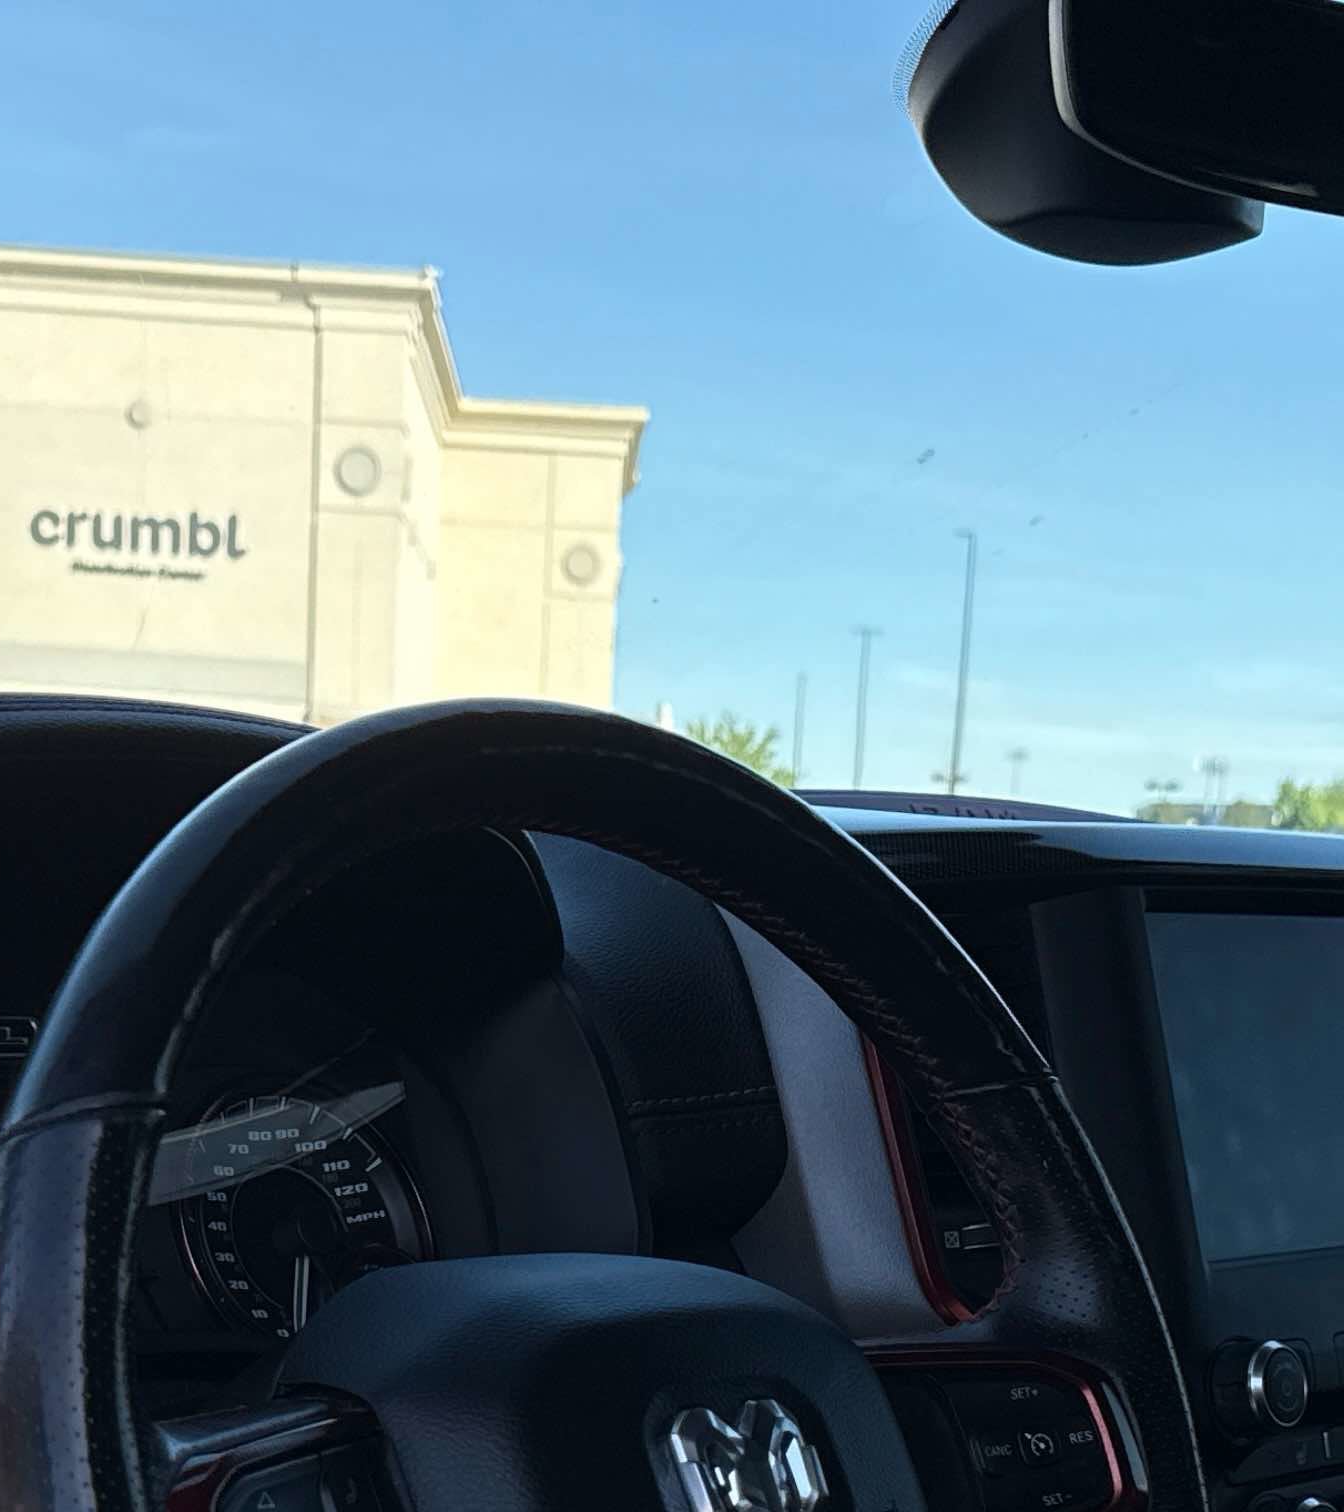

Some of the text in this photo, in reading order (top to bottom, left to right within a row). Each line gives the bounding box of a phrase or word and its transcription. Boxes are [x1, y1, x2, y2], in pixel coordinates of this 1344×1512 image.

[30, 509, 246, 559] crumbl
[295, 1140, 327, 1152] 100
[322, 1159, 352, 1173] 110
[334, 1182, 369, 1197] 120
[346, 1210, 386, 1225] MPH
[208, 1221, 227, 1231] 40
[227, 1280, 248, 1290] 20
[1068, 1430, 1095, 1445] RES
